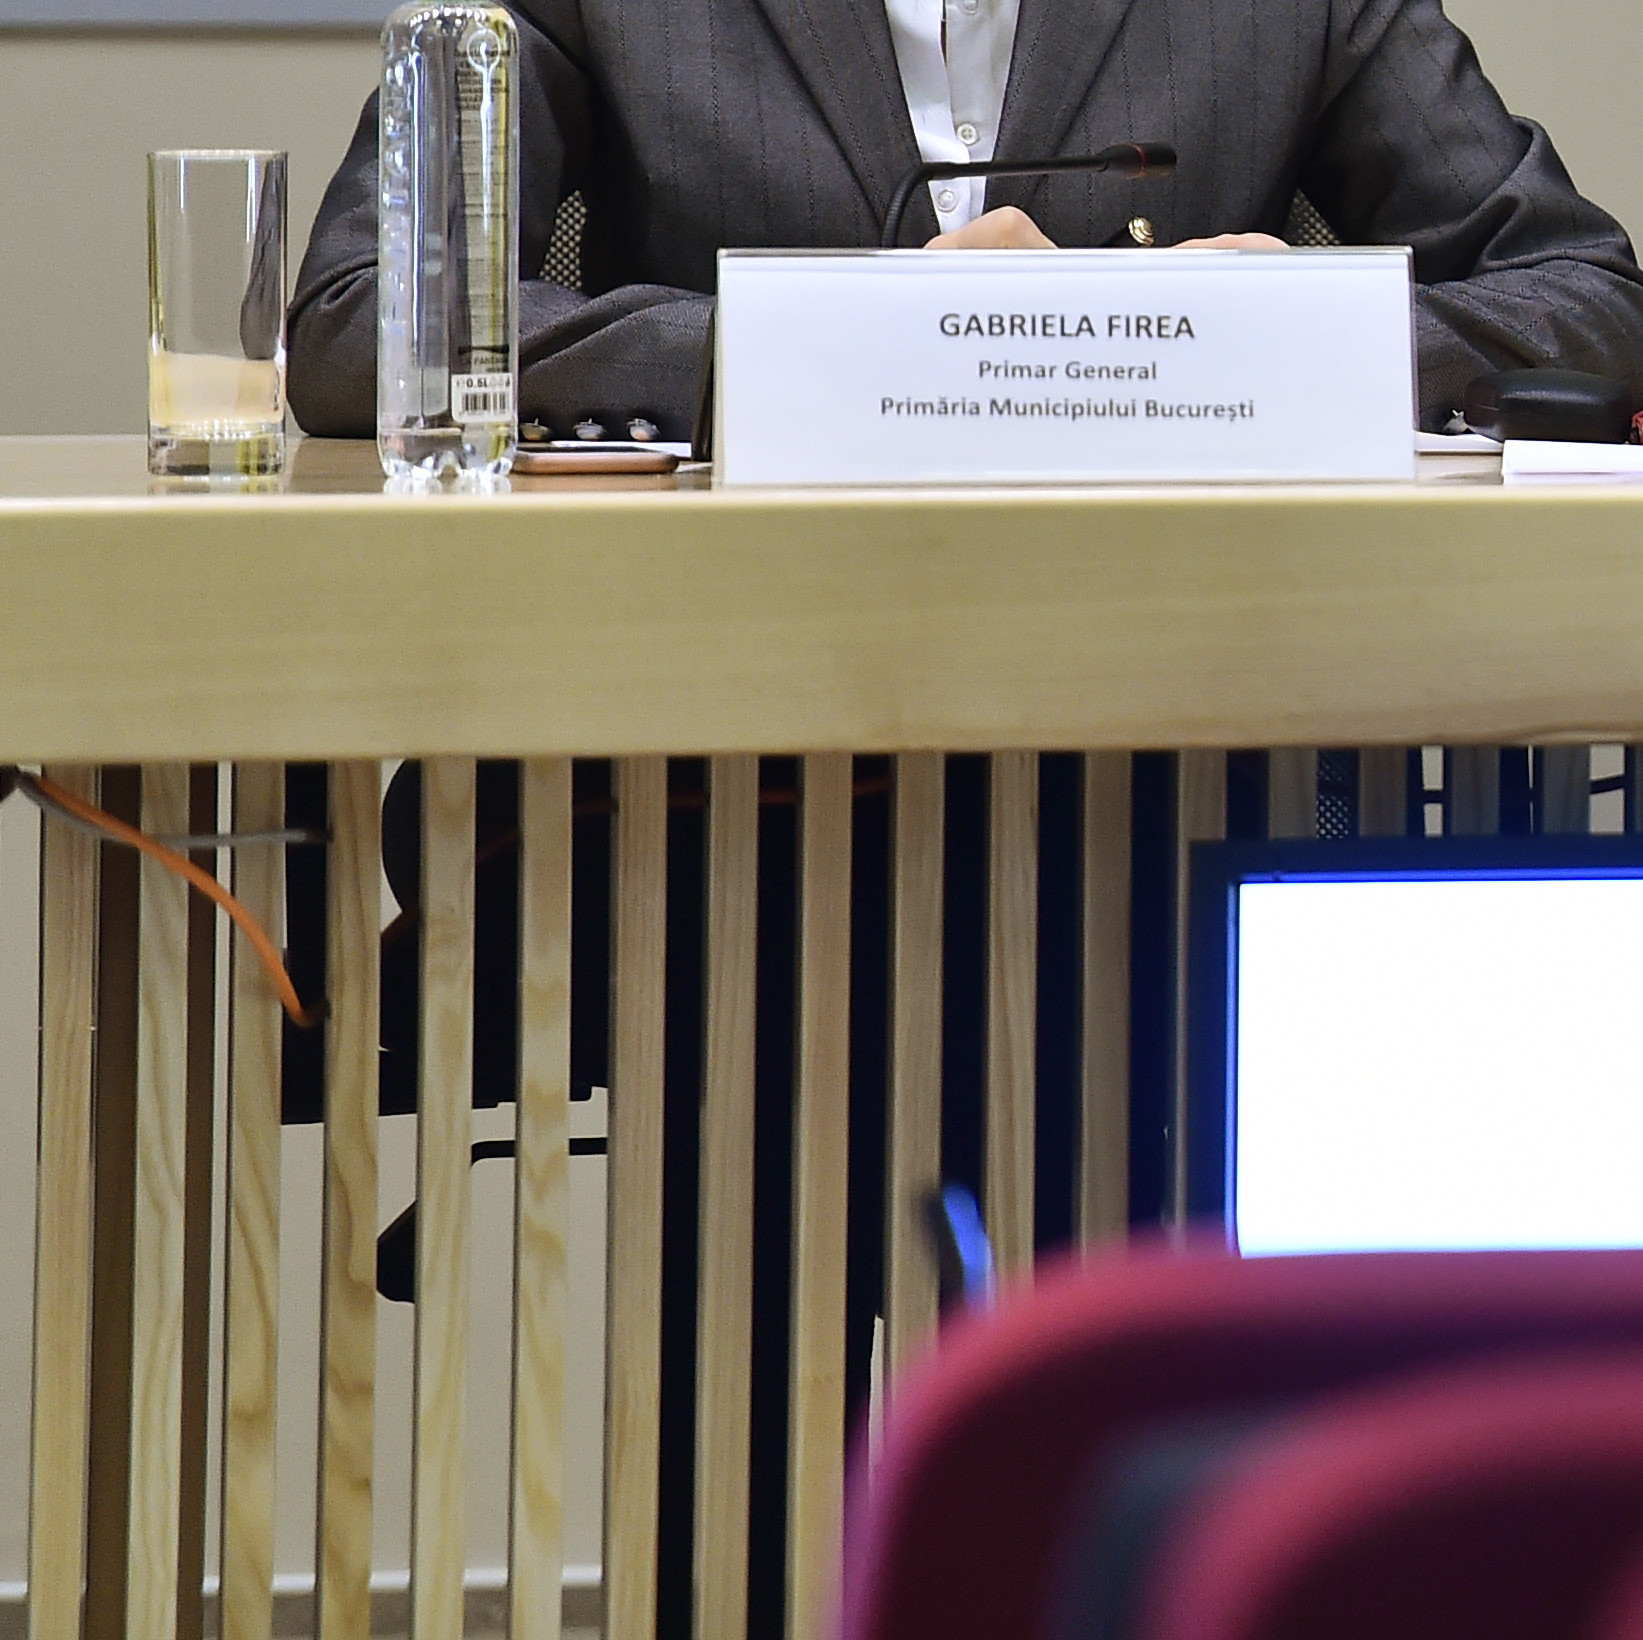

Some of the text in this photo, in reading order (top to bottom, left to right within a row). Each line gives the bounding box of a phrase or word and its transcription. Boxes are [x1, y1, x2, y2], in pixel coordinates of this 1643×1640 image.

[938, 313, 1196, 340] GABRIELA FIREA
[978, 360, 1158, 381] Primar General
[880, 396, 1255, 422] Primăria Municipiului București
